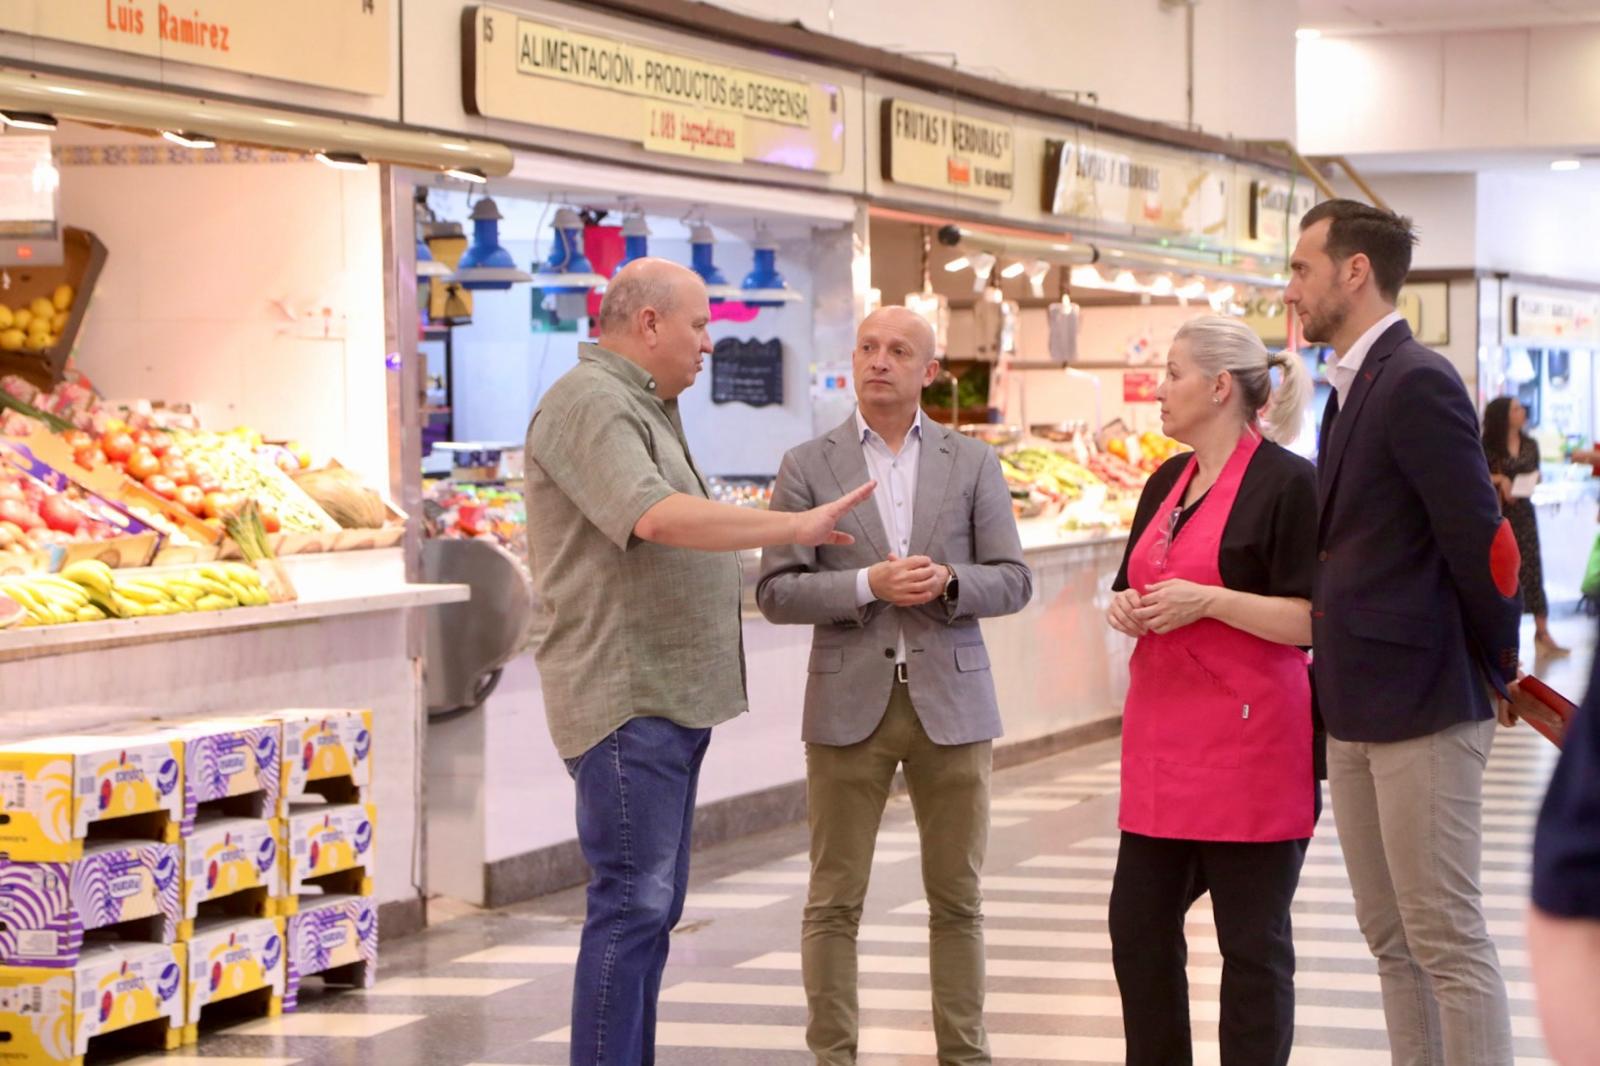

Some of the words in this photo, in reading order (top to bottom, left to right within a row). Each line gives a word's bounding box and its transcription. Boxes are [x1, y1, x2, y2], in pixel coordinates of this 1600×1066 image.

[106, 0, 144, 35] Luis
[483, 16, 494, 42] 15
[520, 33, 634, 84] ALIMENTACIÓN
[645, 61, 727, 107] PRODUCTOS
[729, 80, 744, 108] de
[748, 83, 809, 121] DESPENSA
[895, 107, 939, 146] FRUTAS
[951, 119, 1003, 159] VERDURAS
